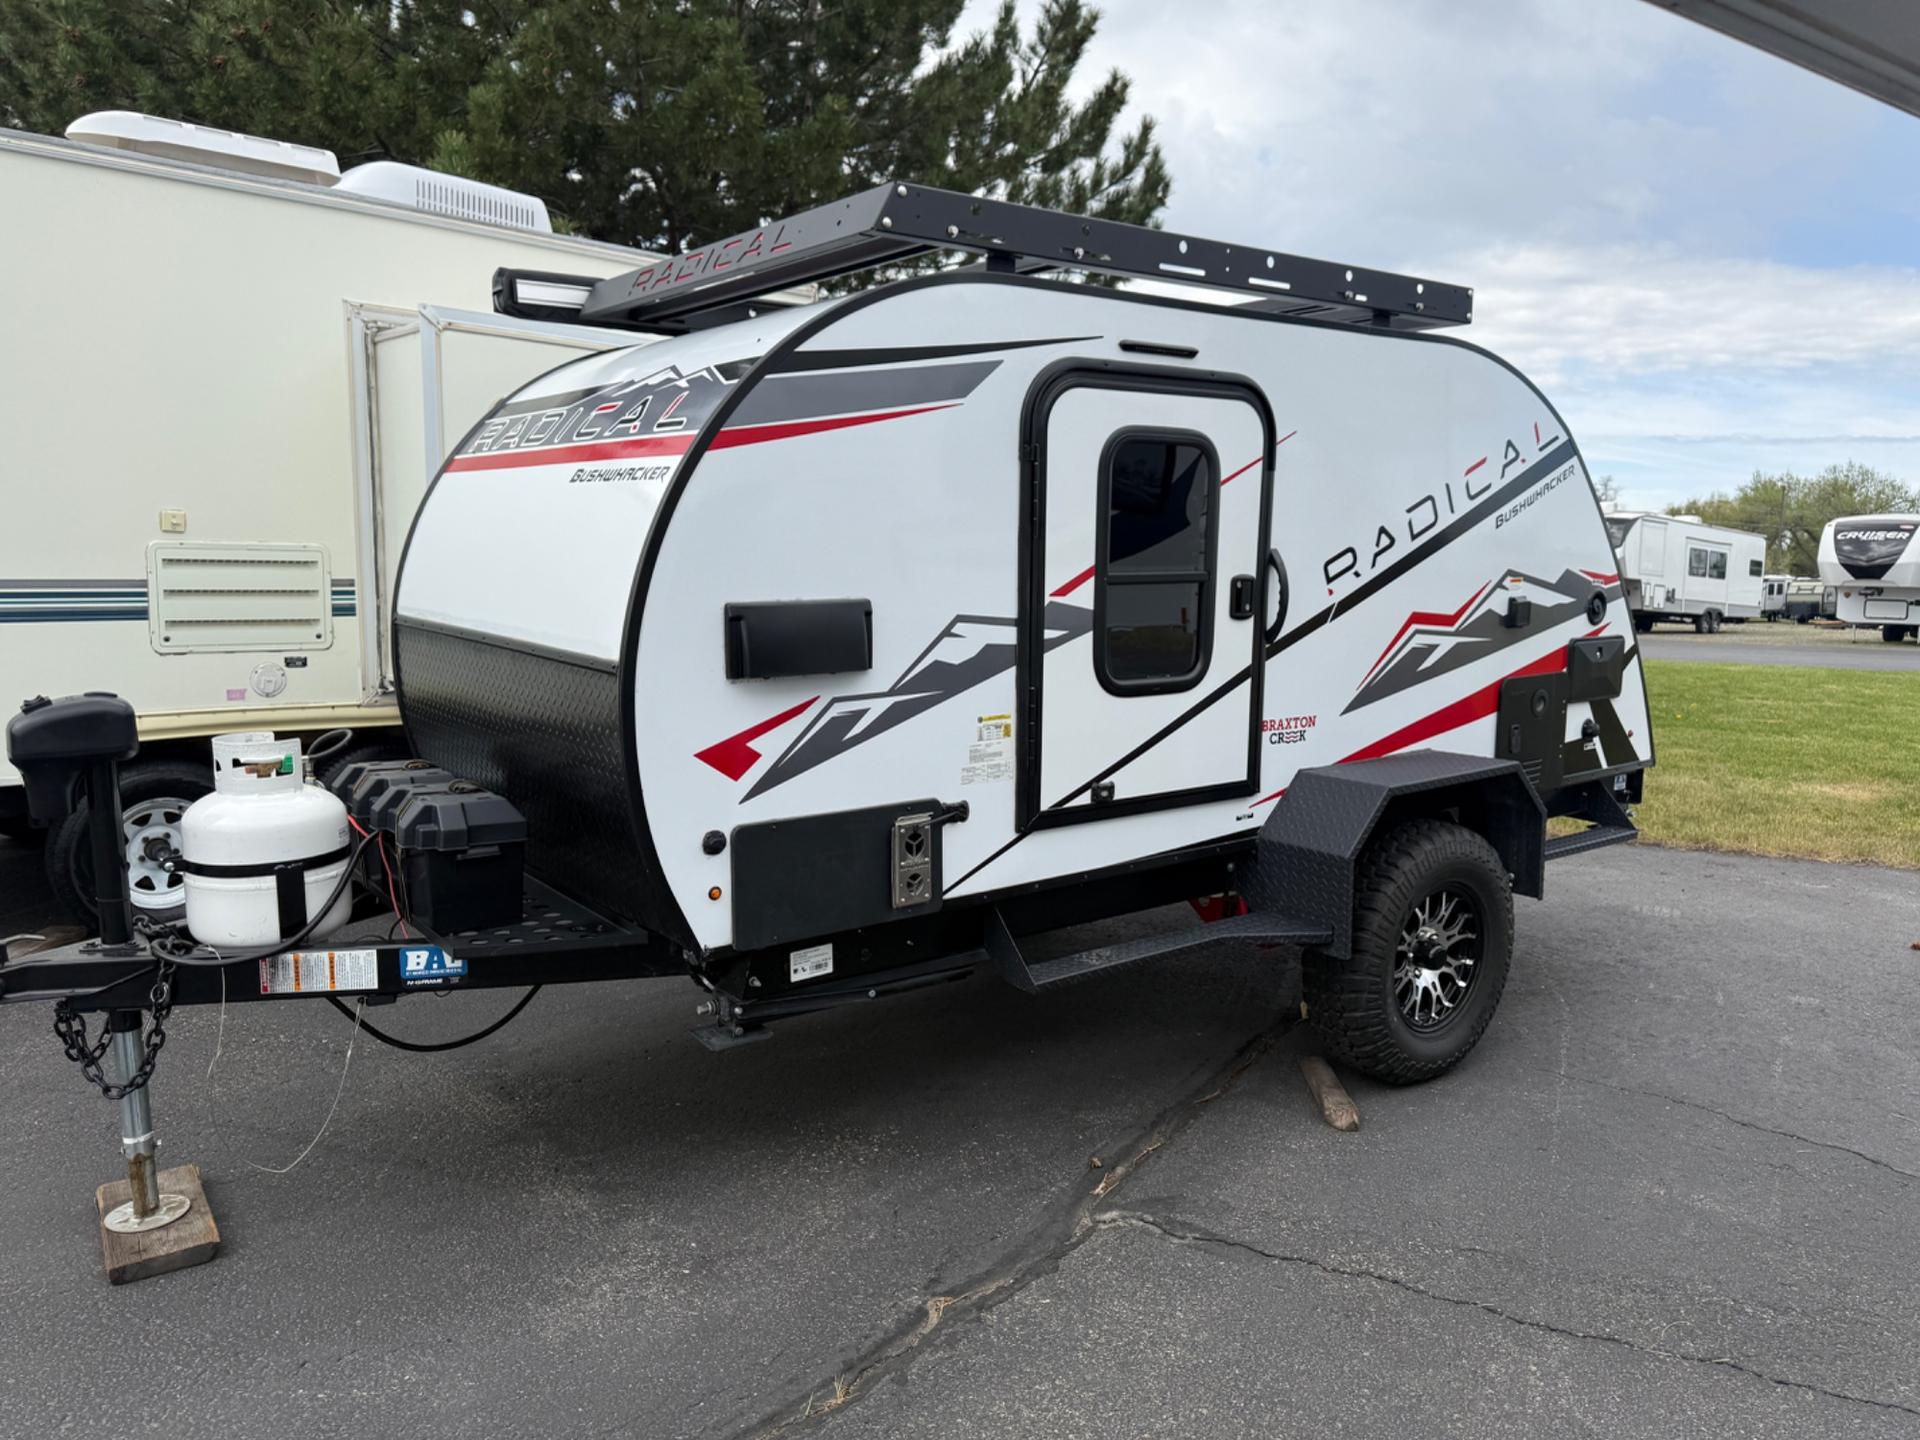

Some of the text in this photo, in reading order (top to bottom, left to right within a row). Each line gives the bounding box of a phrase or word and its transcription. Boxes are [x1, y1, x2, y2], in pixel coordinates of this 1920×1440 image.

[628, 225, 792, 296] RADICAL
[468, 391, 690, 452] RADICAL
[570, 466, 670, 482] BUSHWHACKER
[1495, 465, 1576, 529] BUSHWHACKER
[1323, 421, 1560, 596] RADICAL
[1837, 531, 1910, 540] CRUISER
[1261, 715, 1316, 732] BRAXTON
